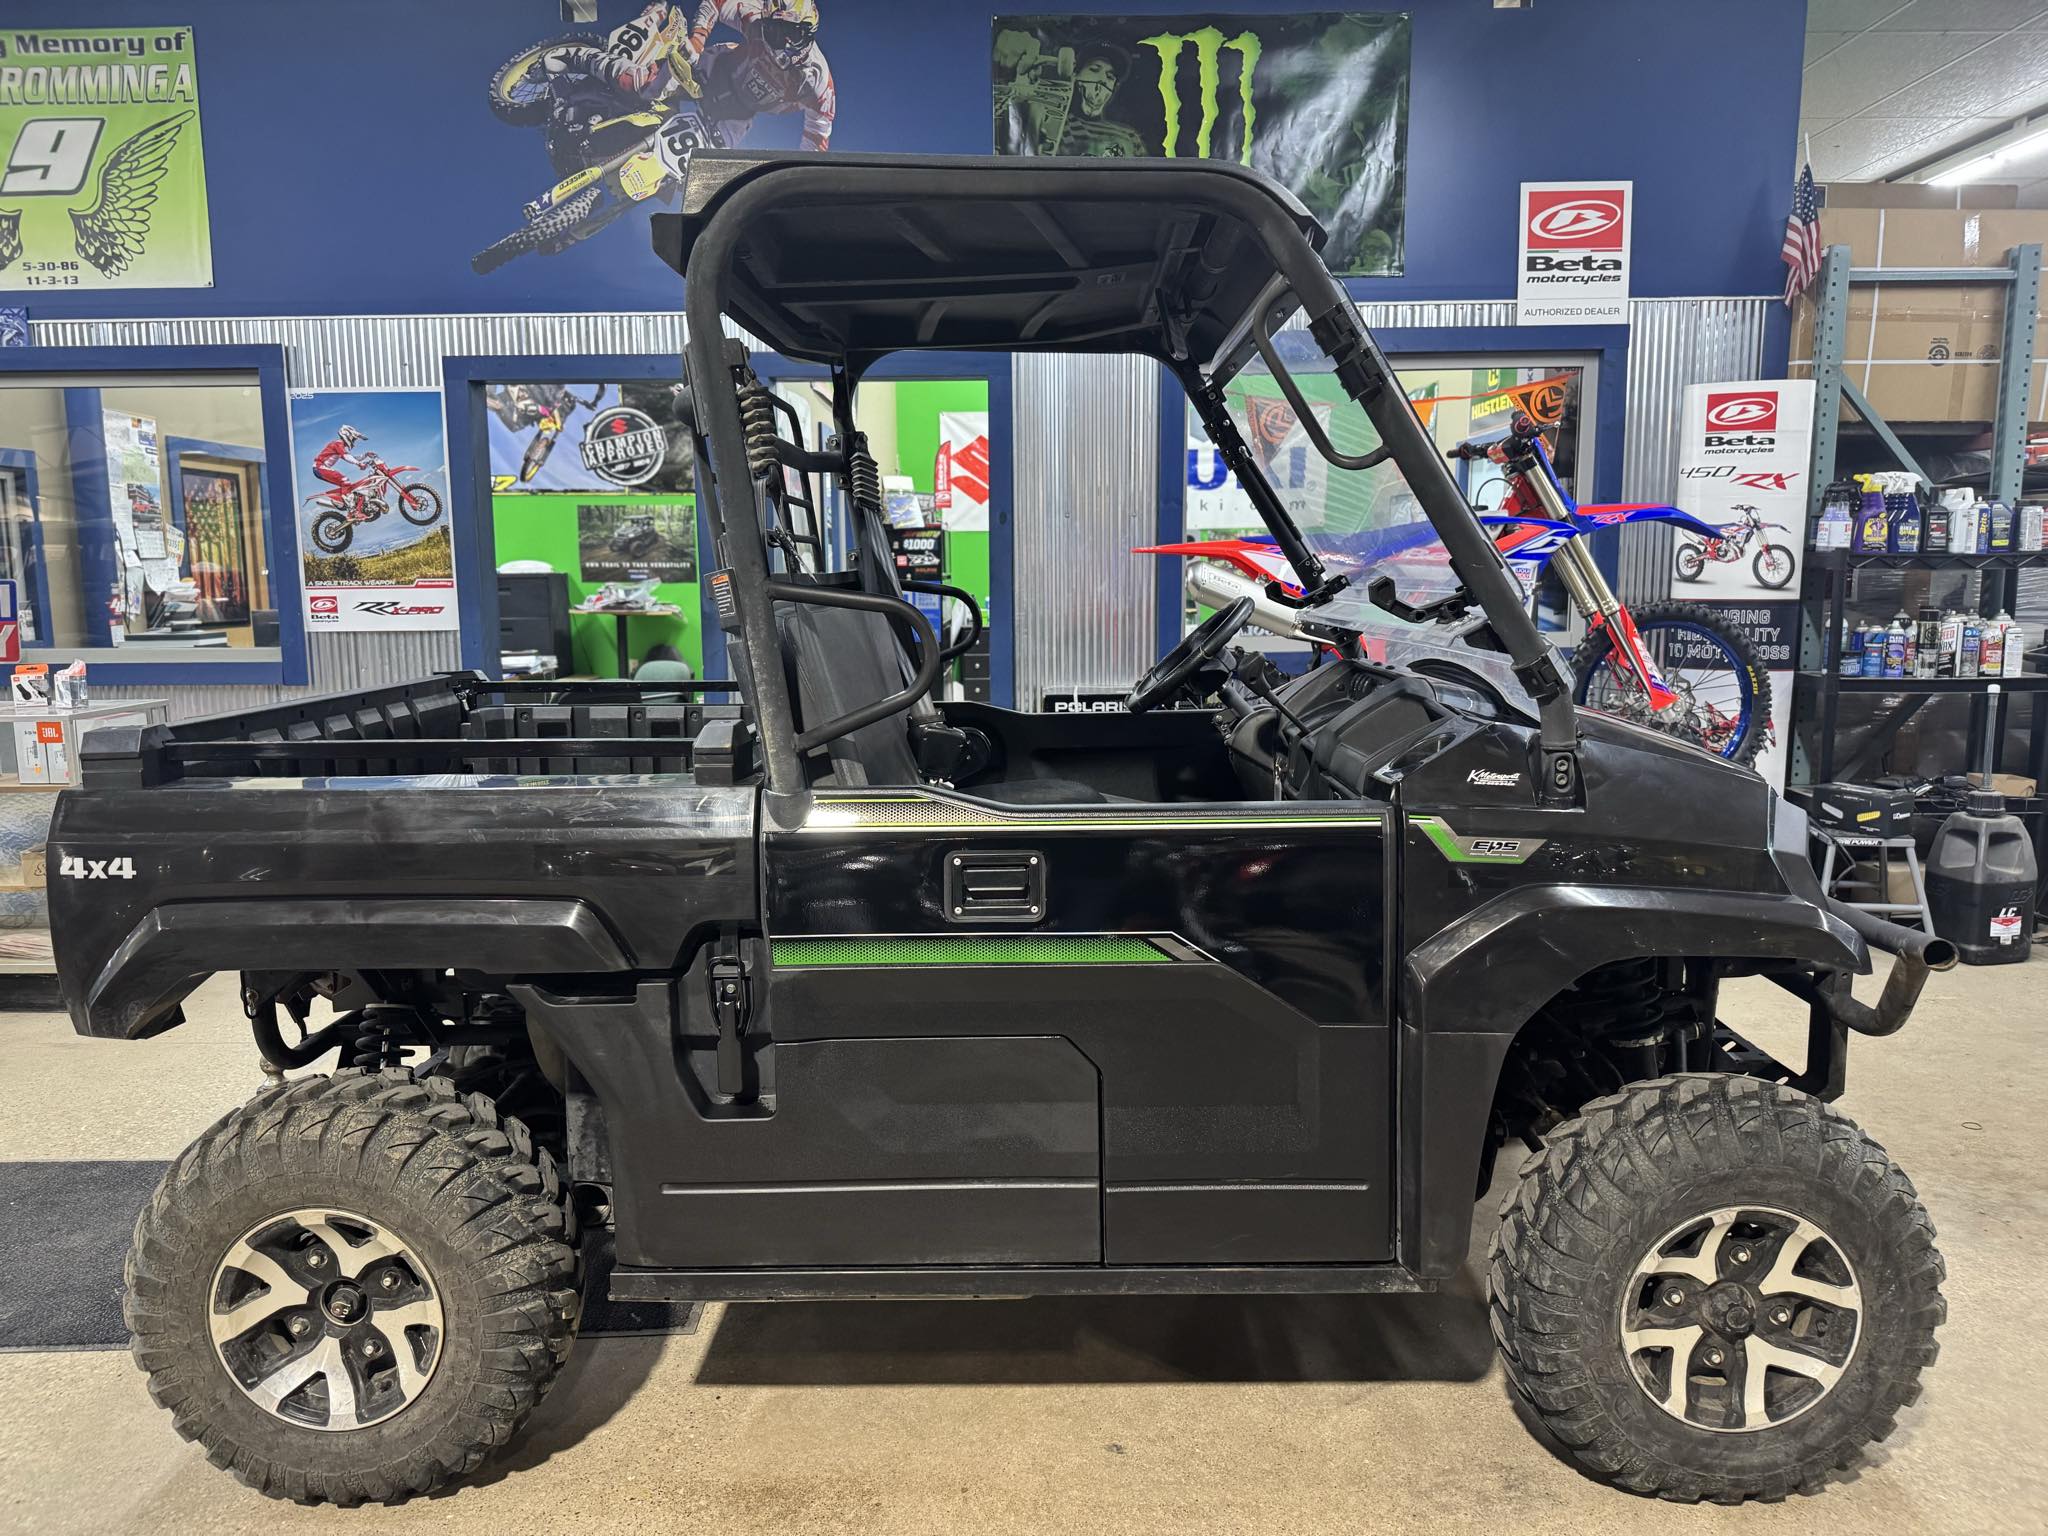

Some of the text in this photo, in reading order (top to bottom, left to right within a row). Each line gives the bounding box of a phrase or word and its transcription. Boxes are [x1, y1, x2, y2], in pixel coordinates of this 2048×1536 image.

[16, 34, 145, 56] Memory
[154, 31, 187, 52] of
[1, 117, 106, 196] 9
[22, 261, 79, 271] 5-30-86
[1526, 255, 1622, 272] Beta
[26, 275, 79, 285] 11-3-13
[1526, 274, 1622, 285] motorcycles
[1524, 307, 1620, 317] AUTHORIZED DEALER
[585, 430, 662, 456] CHAMPION
[1704, 434, 1776, 447] Beta
[588, 440, 665, 466] APPROVED
[1704, 447, 1775, 455] motorcycles
[1680, 465, 1737, 479] 450
[903, 538, 935, 550] $1000
[1054, 701, 1127, 714] POLARI
[41, 727, 59, 738] JBL
[59, 857, 136, 880] 4x4
